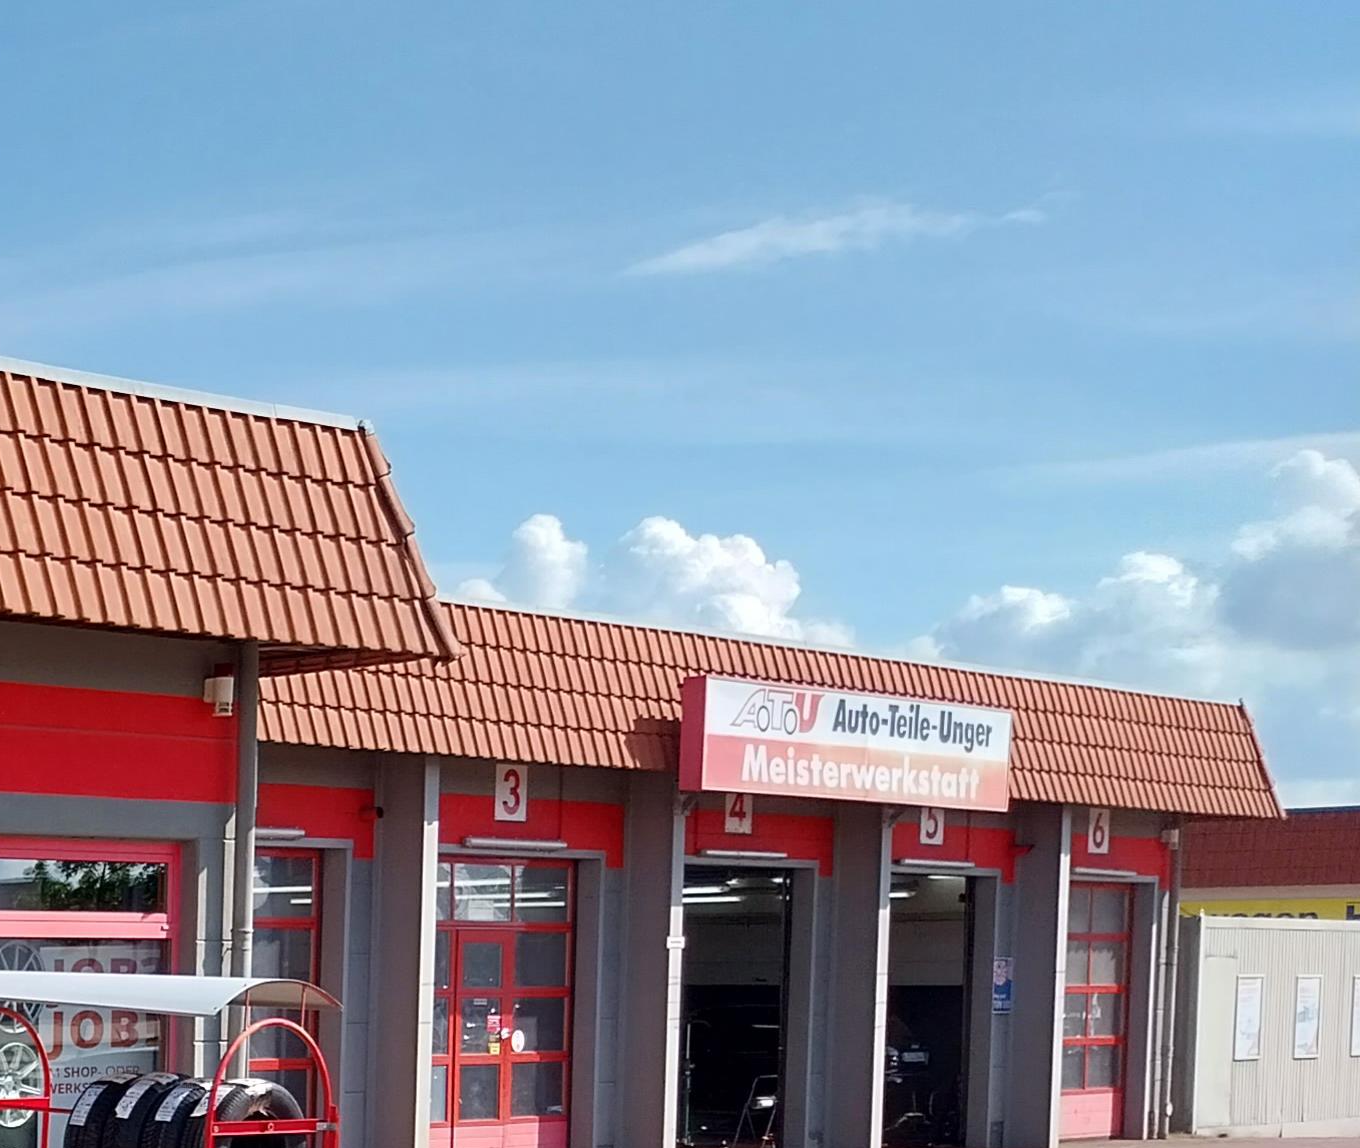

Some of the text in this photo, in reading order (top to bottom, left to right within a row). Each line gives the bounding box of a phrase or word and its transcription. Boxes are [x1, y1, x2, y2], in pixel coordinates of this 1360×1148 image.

[832, 698, 993, 753] Auto-Teile-Unger
[740, 743, 981, 799] Meisterwerkstatt
[501, 768, 521, 816] 3
[729, 794, 747, 822] 4
[925, 808, 939, 840] 5
[1091, 815, 1105, 849] 6
[63, 1065, 103, 1079] SHOP-
